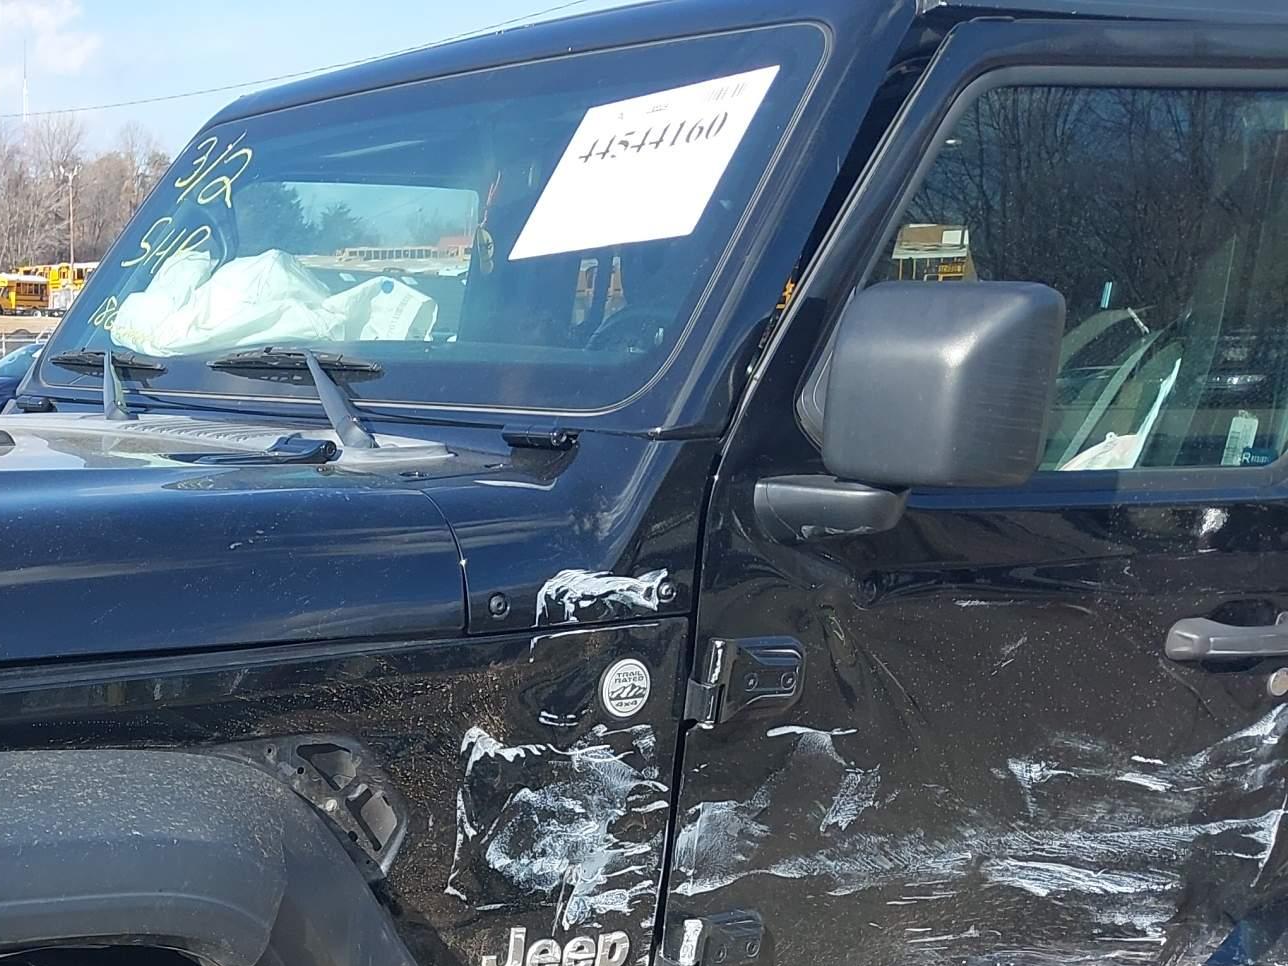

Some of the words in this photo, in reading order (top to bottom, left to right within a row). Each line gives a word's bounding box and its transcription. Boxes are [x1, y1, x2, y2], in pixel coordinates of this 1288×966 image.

[579, 112, 728, 162] 44544160
[617, 670, 643, 678] TRAIL
[614, 675, 644, 684] RATED
